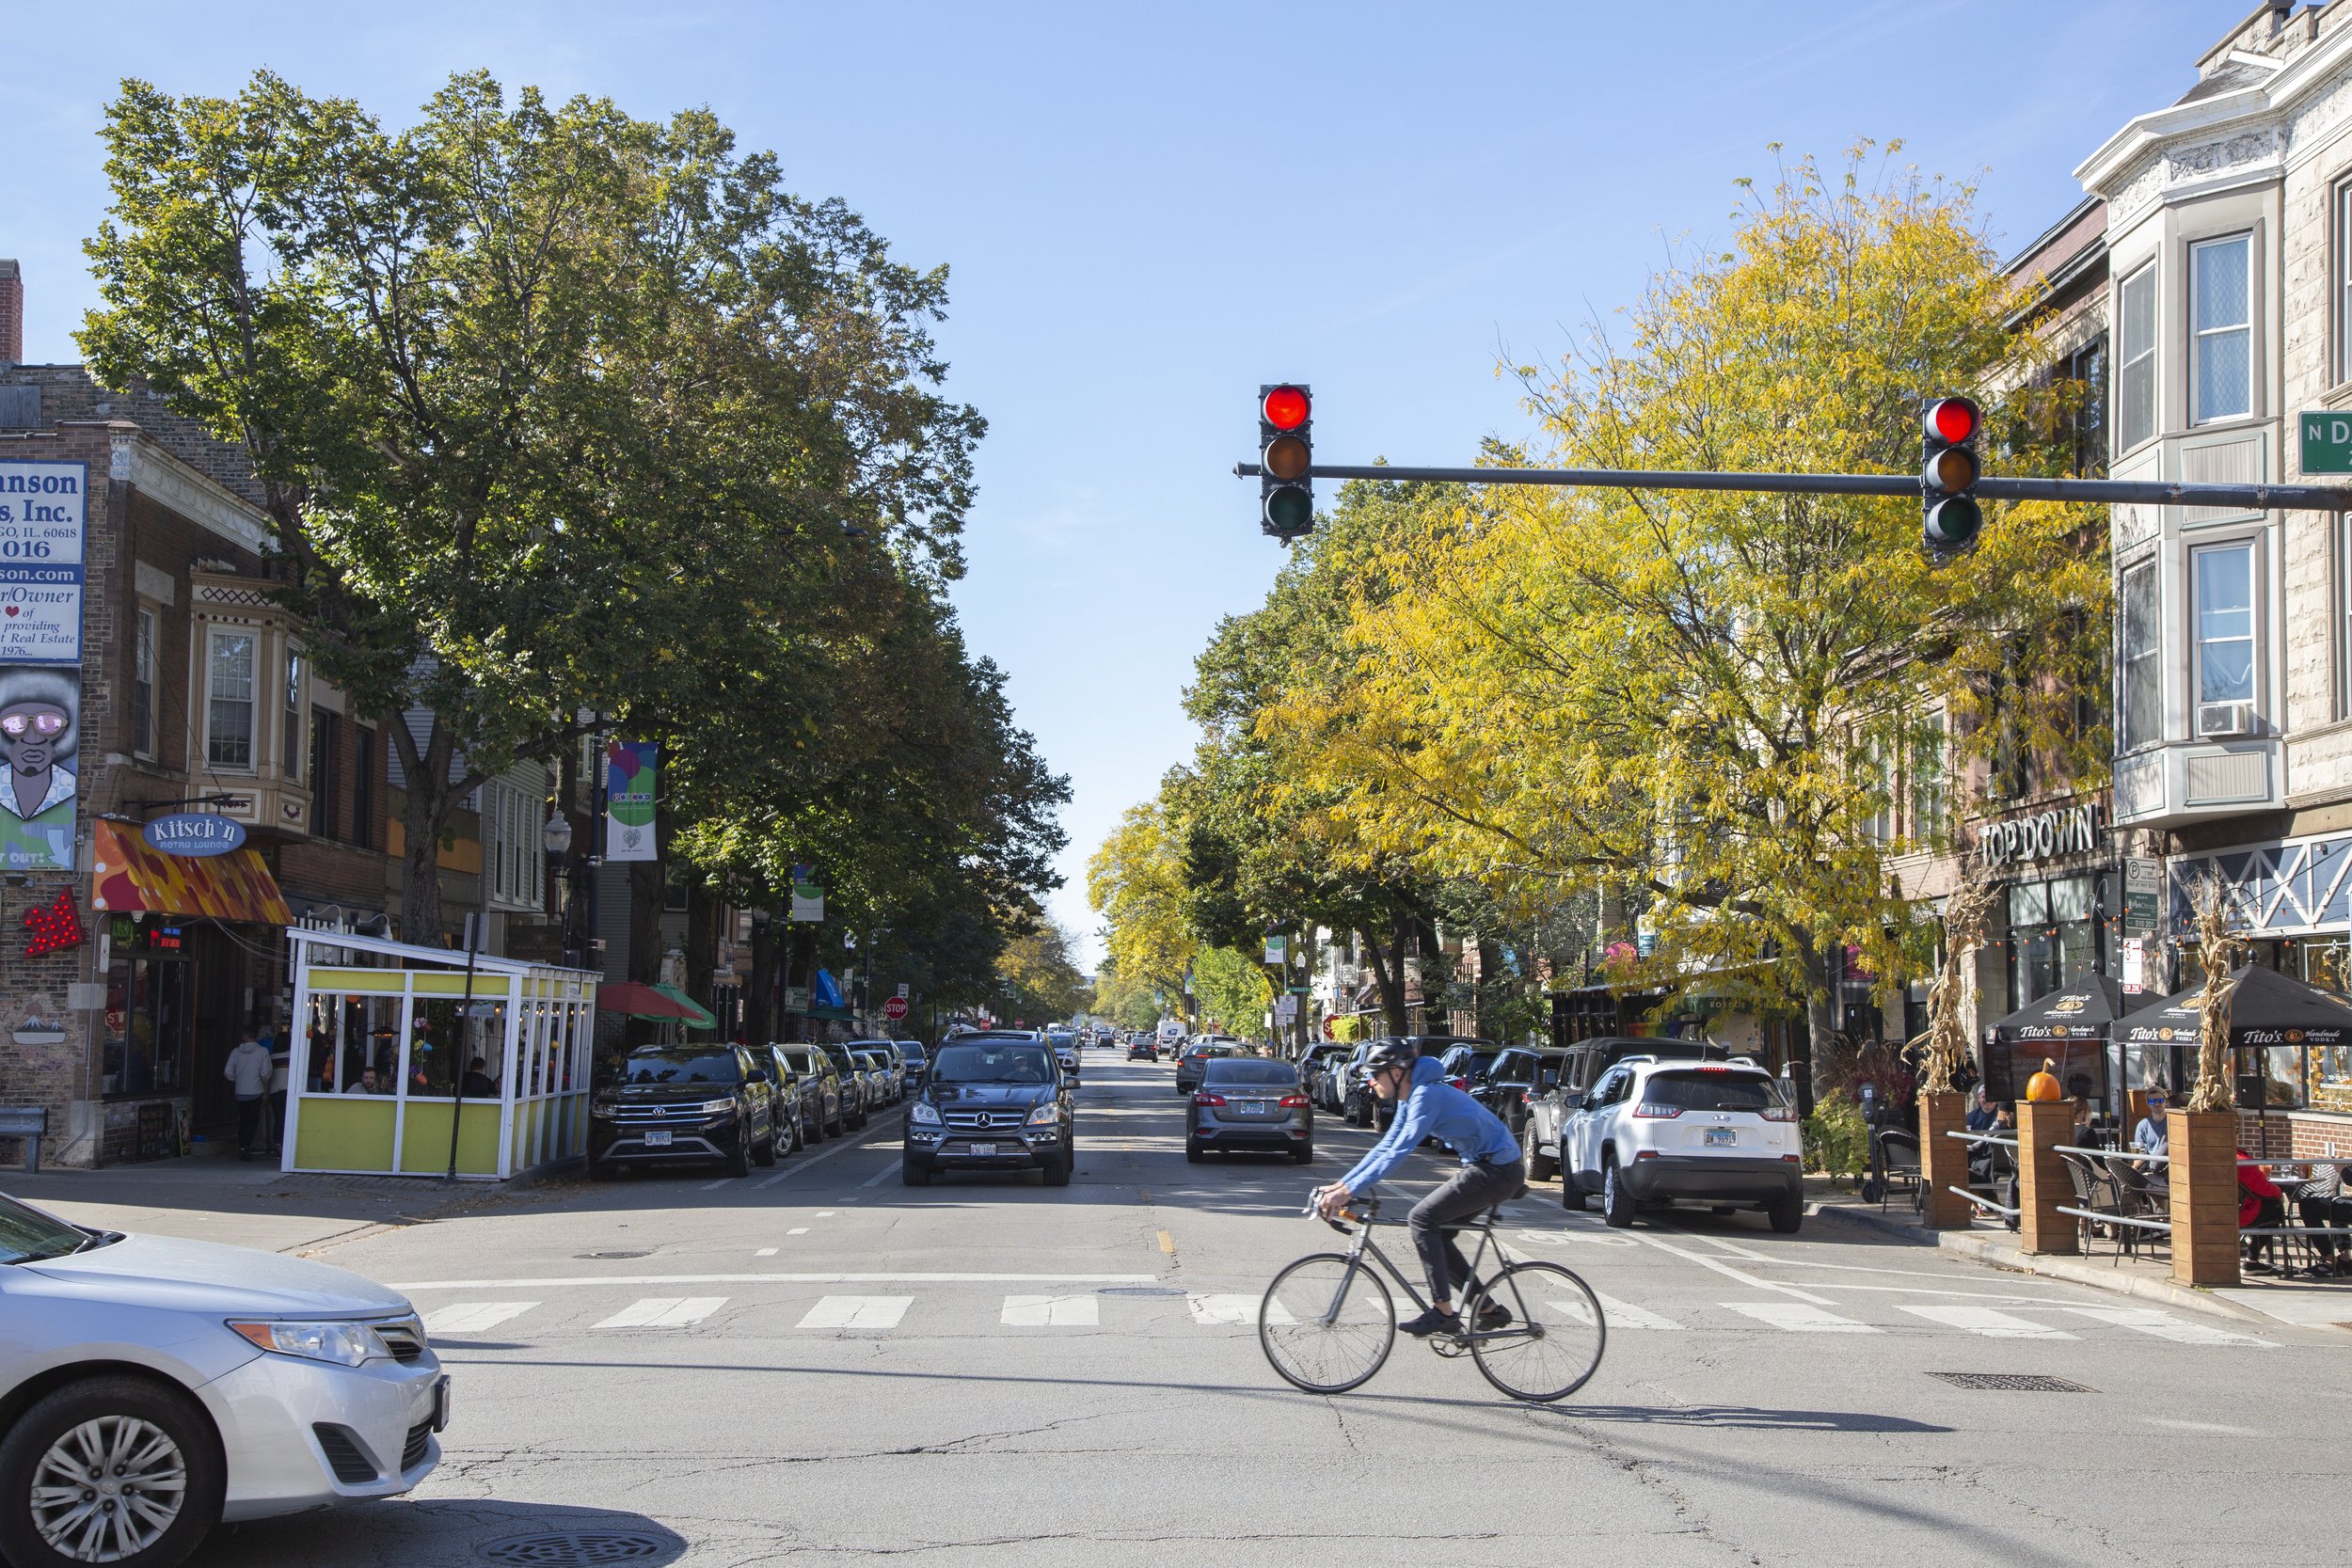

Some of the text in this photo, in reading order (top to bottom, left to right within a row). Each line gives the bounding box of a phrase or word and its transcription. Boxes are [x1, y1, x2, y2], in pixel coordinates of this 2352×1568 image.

[2309, 420, 2352, 444] N D
[23, 499, 72, 522] Inc.
[24, 528, 40, 537] IL.
[43, 529, 76, 538] 60618
[3, 541, 50, 558] 016
[1, 587, 73, 603] r/Owner
[23, 608, 36, 621] of
[4, 621, 60, 633] providing
[11, 633, 36, 643] Real
[40, 633, 75, 643] Estate
[2, 646, 33, 656] 1976...
[160, 841, 229, 849] RETRO LOUNGE
[886, 1004, 906, 1013] STOP
[2305, 1029, 2341, 1037] Handmade
[1717, 1134, 1737, 1144] 96919
